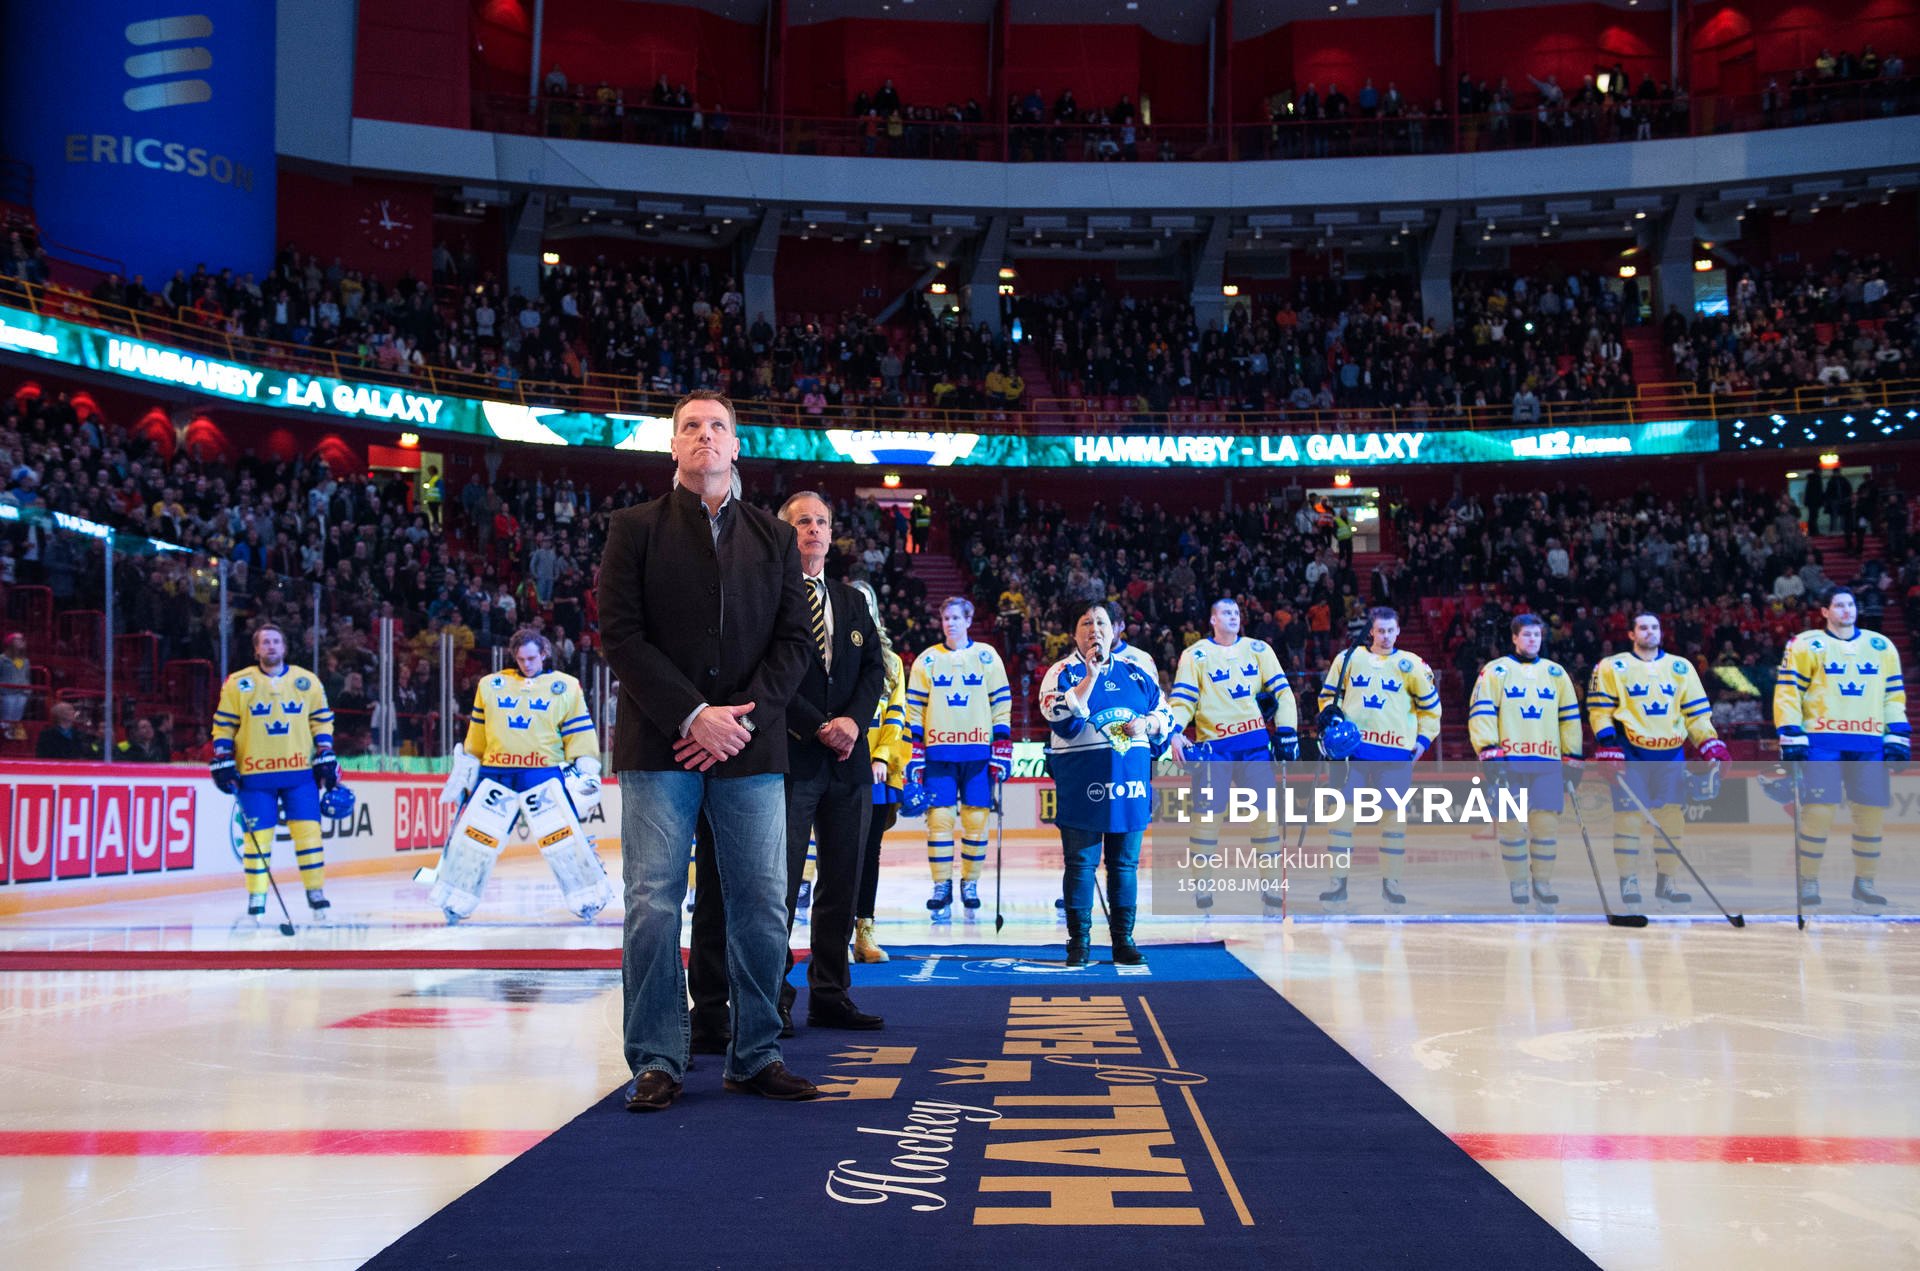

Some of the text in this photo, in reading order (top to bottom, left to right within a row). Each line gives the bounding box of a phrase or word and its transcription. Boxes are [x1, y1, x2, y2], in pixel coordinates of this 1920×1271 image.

[65, 134, 254, 192] ERICSSON
[109, 338, 264, 398] HAMMARBY
[287, 378, 326, 408] LA
[332, 385, 443, 424] GALAXY
[1074, 436, 1235, 462] HAMMARBY
[1261, 436, 1299, 462] LA
[1306, 432, 1424, 460] GALAXY
[1572, 435, 1632, 454] Arena
[928, 727, 991, 744] Scandic
[0, 797, 192, 866] UHAUS
[1001, 995, 1143, 1055] FAME
[825, 1098, 1003, 1212] Hockey
[973, 1085, 1206, 1226] HALL
